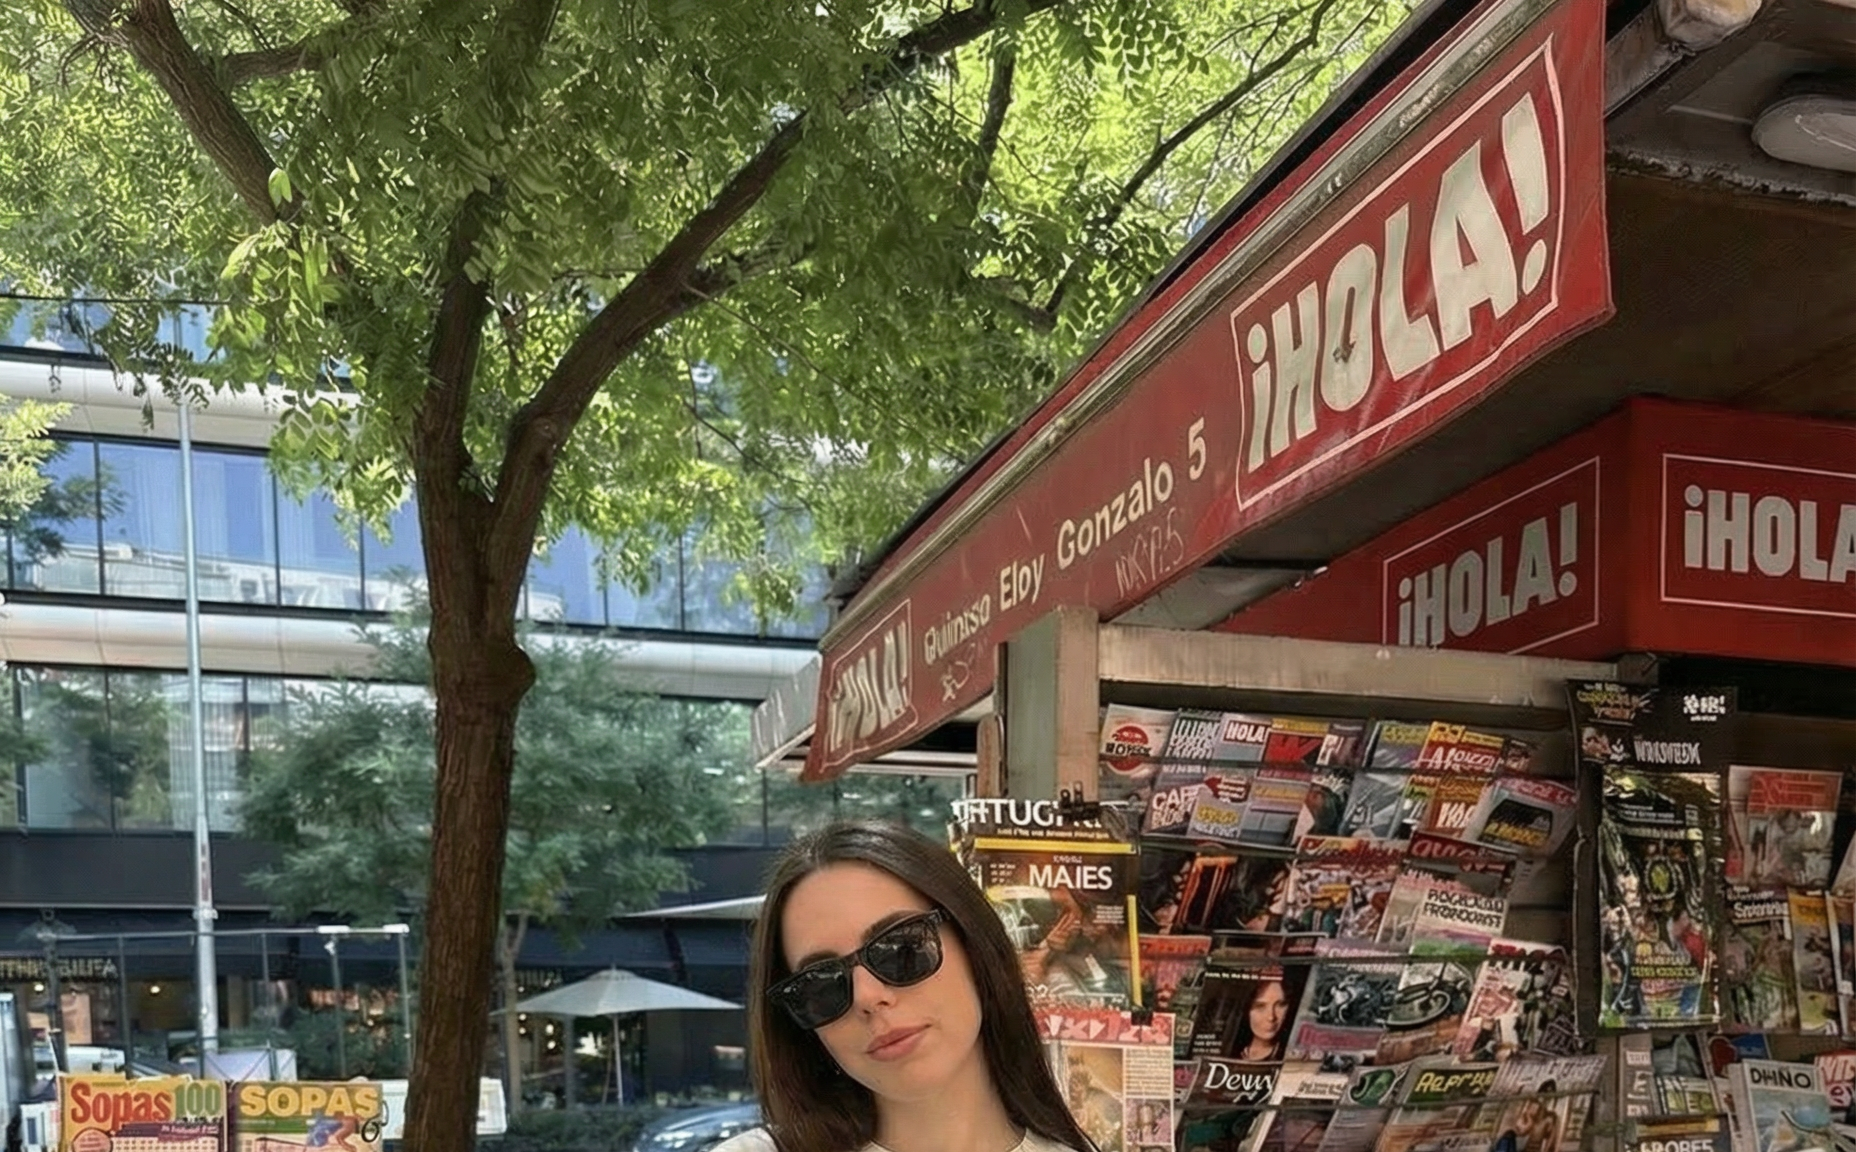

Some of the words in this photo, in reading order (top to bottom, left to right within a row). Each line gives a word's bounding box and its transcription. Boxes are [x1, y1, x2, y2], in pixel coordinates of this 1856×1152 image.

[1245, 91, 1551, 472] ¡HOLA!
[1000, 553, 1045, 611] Eloy
[1057, 466, 1174, 571] Gonzalo
[1187, 418, 1208, 482] 5
[1399, 502, 1578, 646] ¡HOLA!
[70, 1081, 172, 1131] Sopas
[175, 1082, 221, 1118] 100
[240, 1086, 380, 1118] SOPAS
